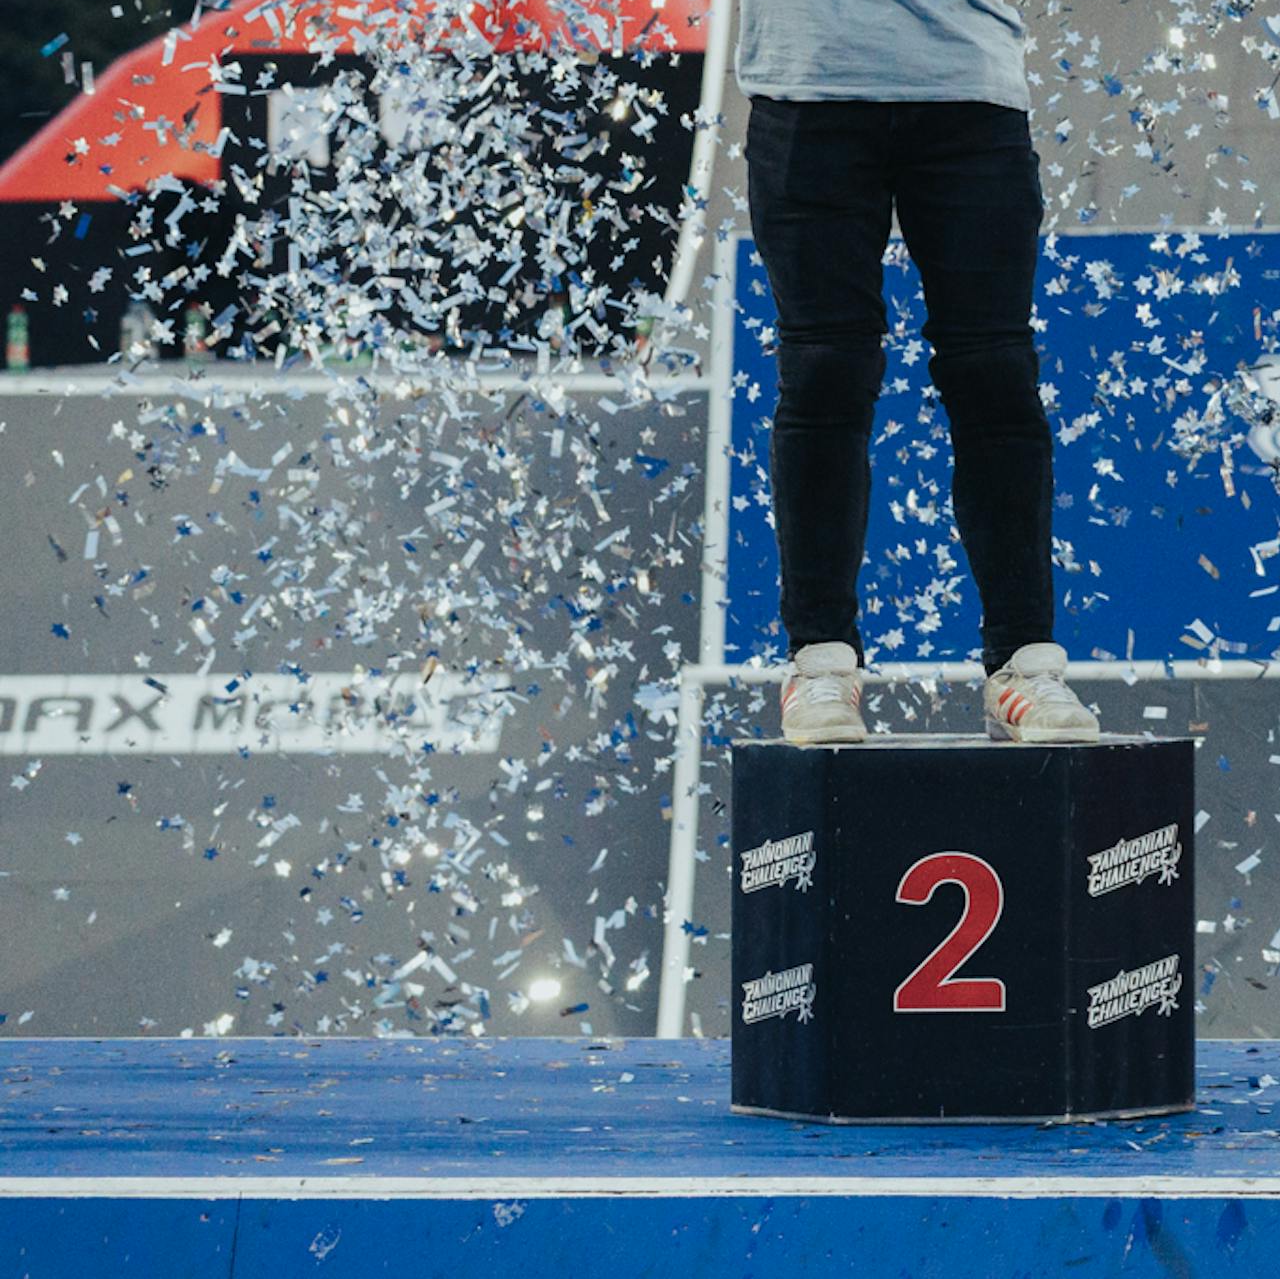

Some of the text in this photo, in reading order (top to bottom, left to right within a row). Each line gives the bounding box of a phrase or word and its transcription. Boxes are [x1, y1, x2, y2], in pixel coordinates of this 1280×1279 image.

[740, 852, 808, 891] CHALLENGE
[1087, 846, 1172, 895] CHALLENGE
[894, 851, 1006, 1012] 2
[1087, 977, 1172, 1026] CHALLENGE
